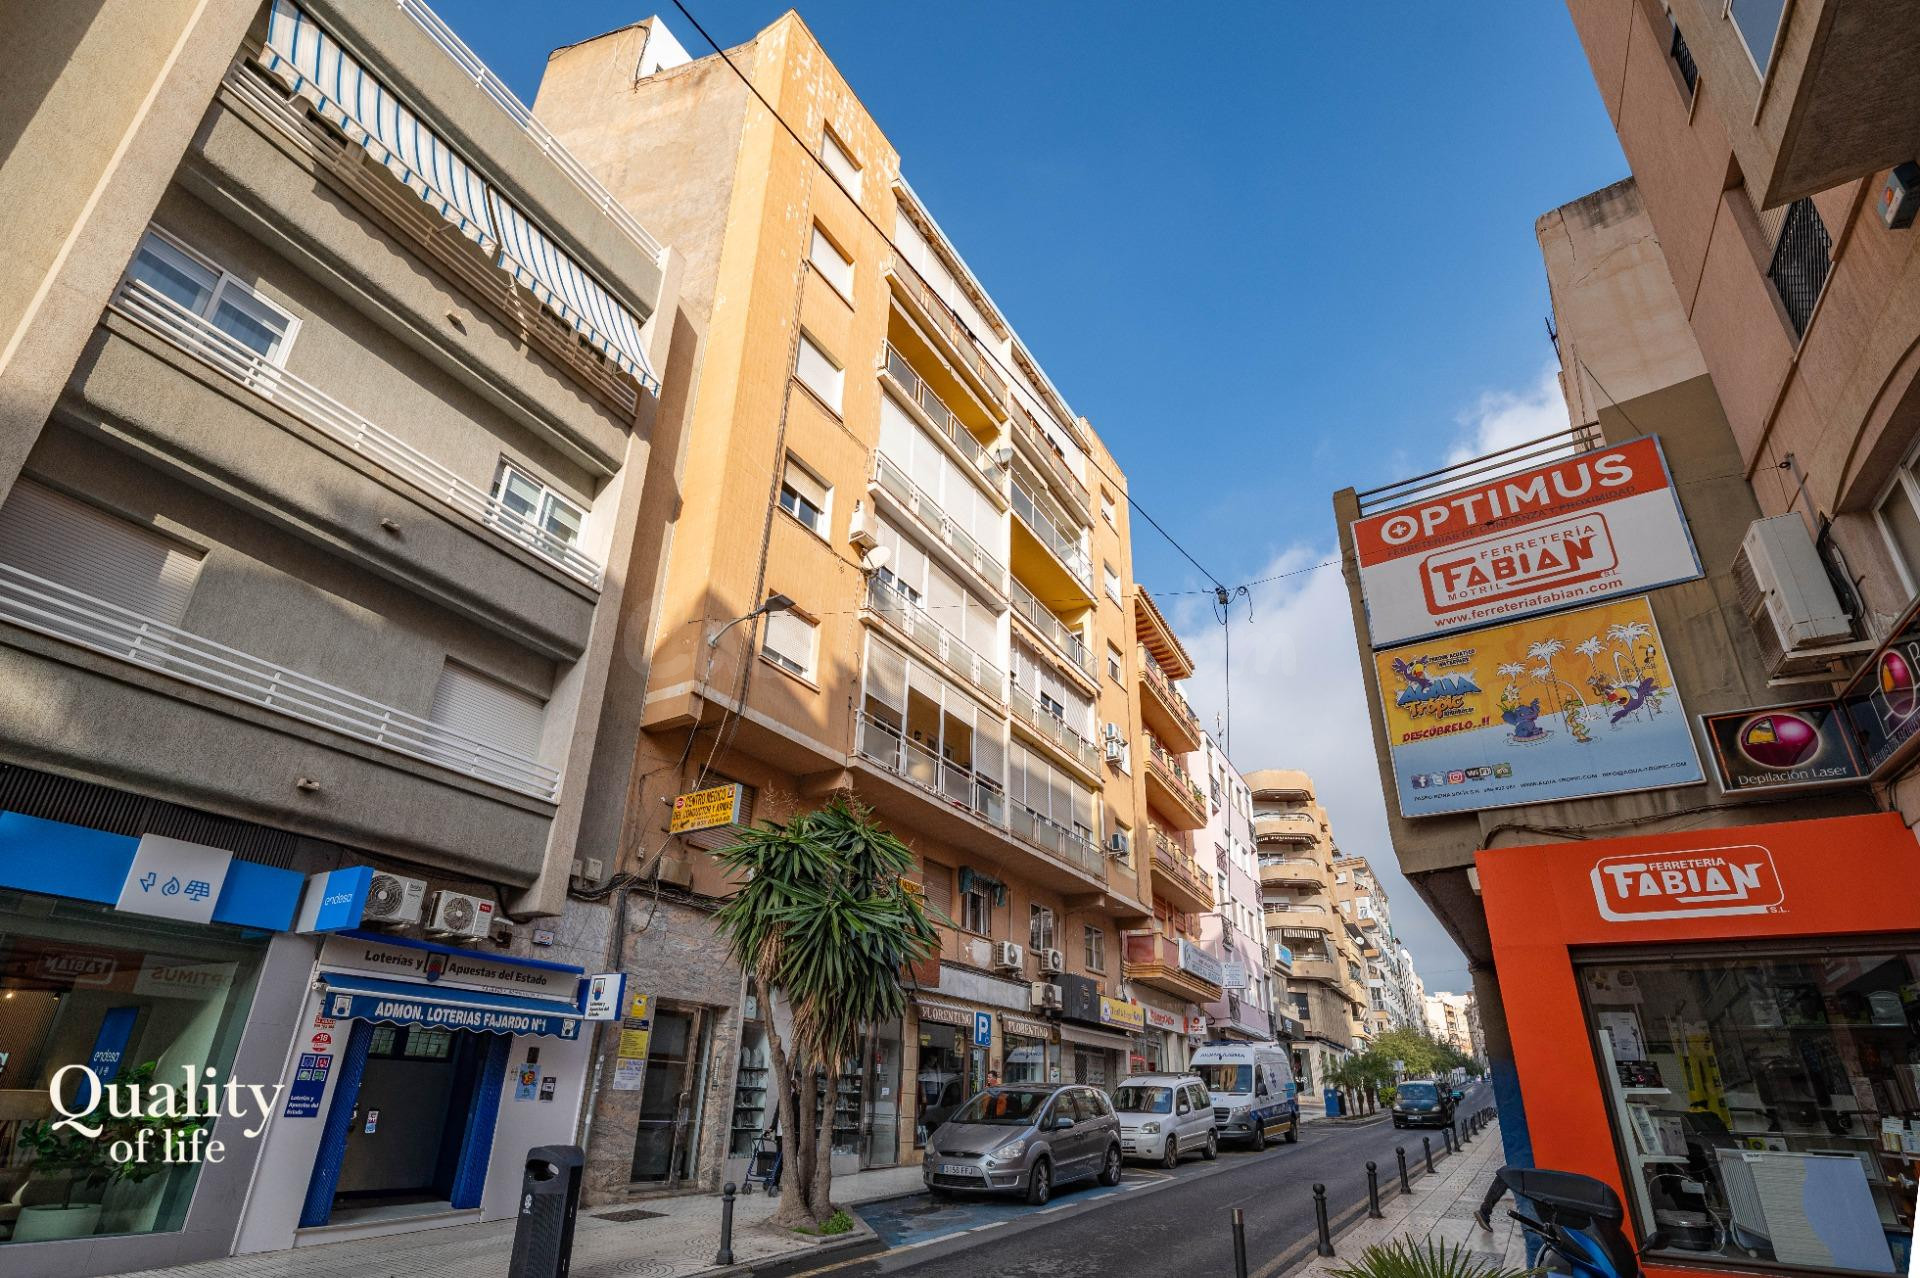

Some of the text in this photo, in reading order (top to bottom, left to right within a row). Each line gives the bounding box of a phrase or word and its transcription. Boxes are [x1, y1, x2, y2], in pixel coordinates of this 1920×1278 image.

[1381, 454, 1633, 545] OPTIMUS
[1480, 525, 1595, 560] FERRETERÍA
[1431, 534, 1598, 593] FABIAN
[1434, 579, 1624, 627] www.ferreteriafabian.com
[1447, 583, 1503, 601] MOTRIL
[1738, 766, 1848, 786] Depilación Laser
[1648, 857, 1727, 871] FERRETERIA
[1603, 862, 1764, 900] FABIAN
[324, 891, 354, 906] endesa
[364, 951, 548, 985] Loterías y Apuestas del Estado
[375, 1001, 424, 1021] ADMON.
[426, 1007, 481, 1026] LOTERIAS
[483, 1012, 529, 1030] FAJARDO
[978, 1015, 989, 1042] P
